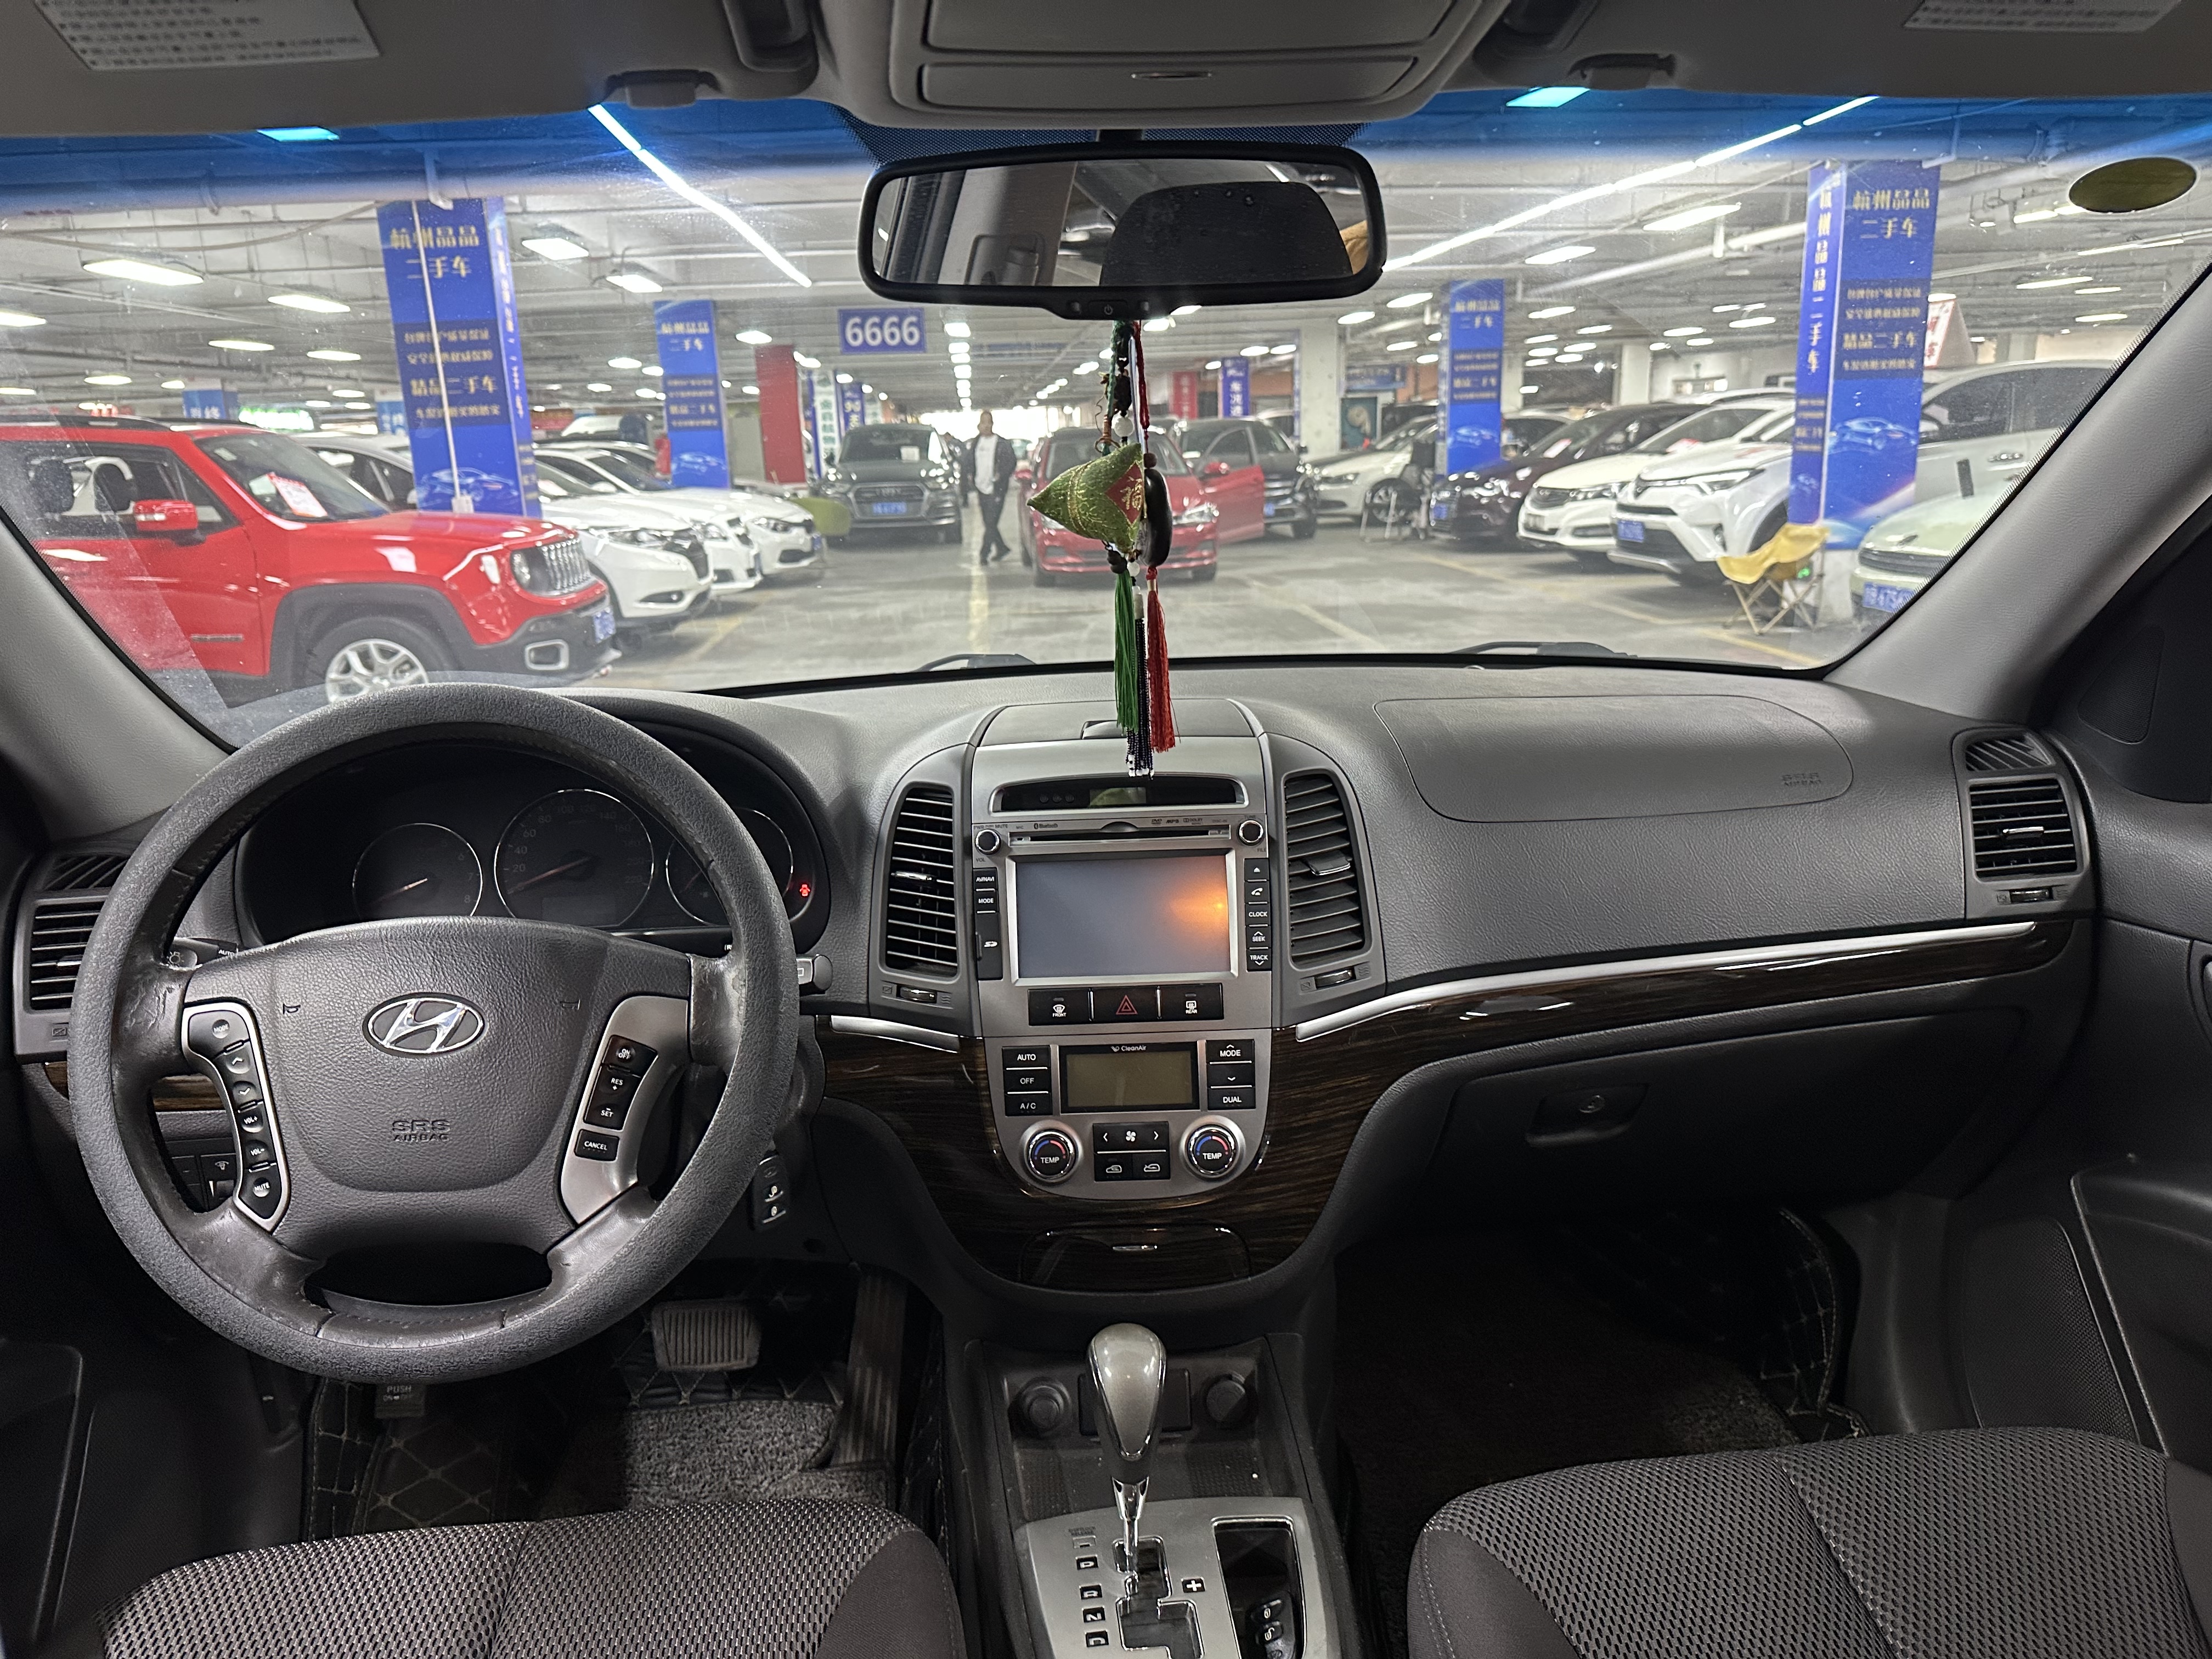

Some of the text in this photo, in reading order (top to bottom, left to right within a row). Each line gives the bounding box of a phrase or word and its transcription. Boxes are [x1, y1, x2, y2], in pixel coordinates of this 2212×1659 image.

[1860, 217, 1917, 238] 二手车
[405, 255, 472, 279] 二手车
[845, 315, 920, 347] 6666
[611, 1077, 623, 1086] RES
[600, 1109, 614, 1118] SET
[392, 1120, 450, 1133] SRS
[393, 1133, 450, 1142] AIRBAG
[584, 1141, 608, 1150] CANCEL
[1086, 1612, 1102, 1621] N
